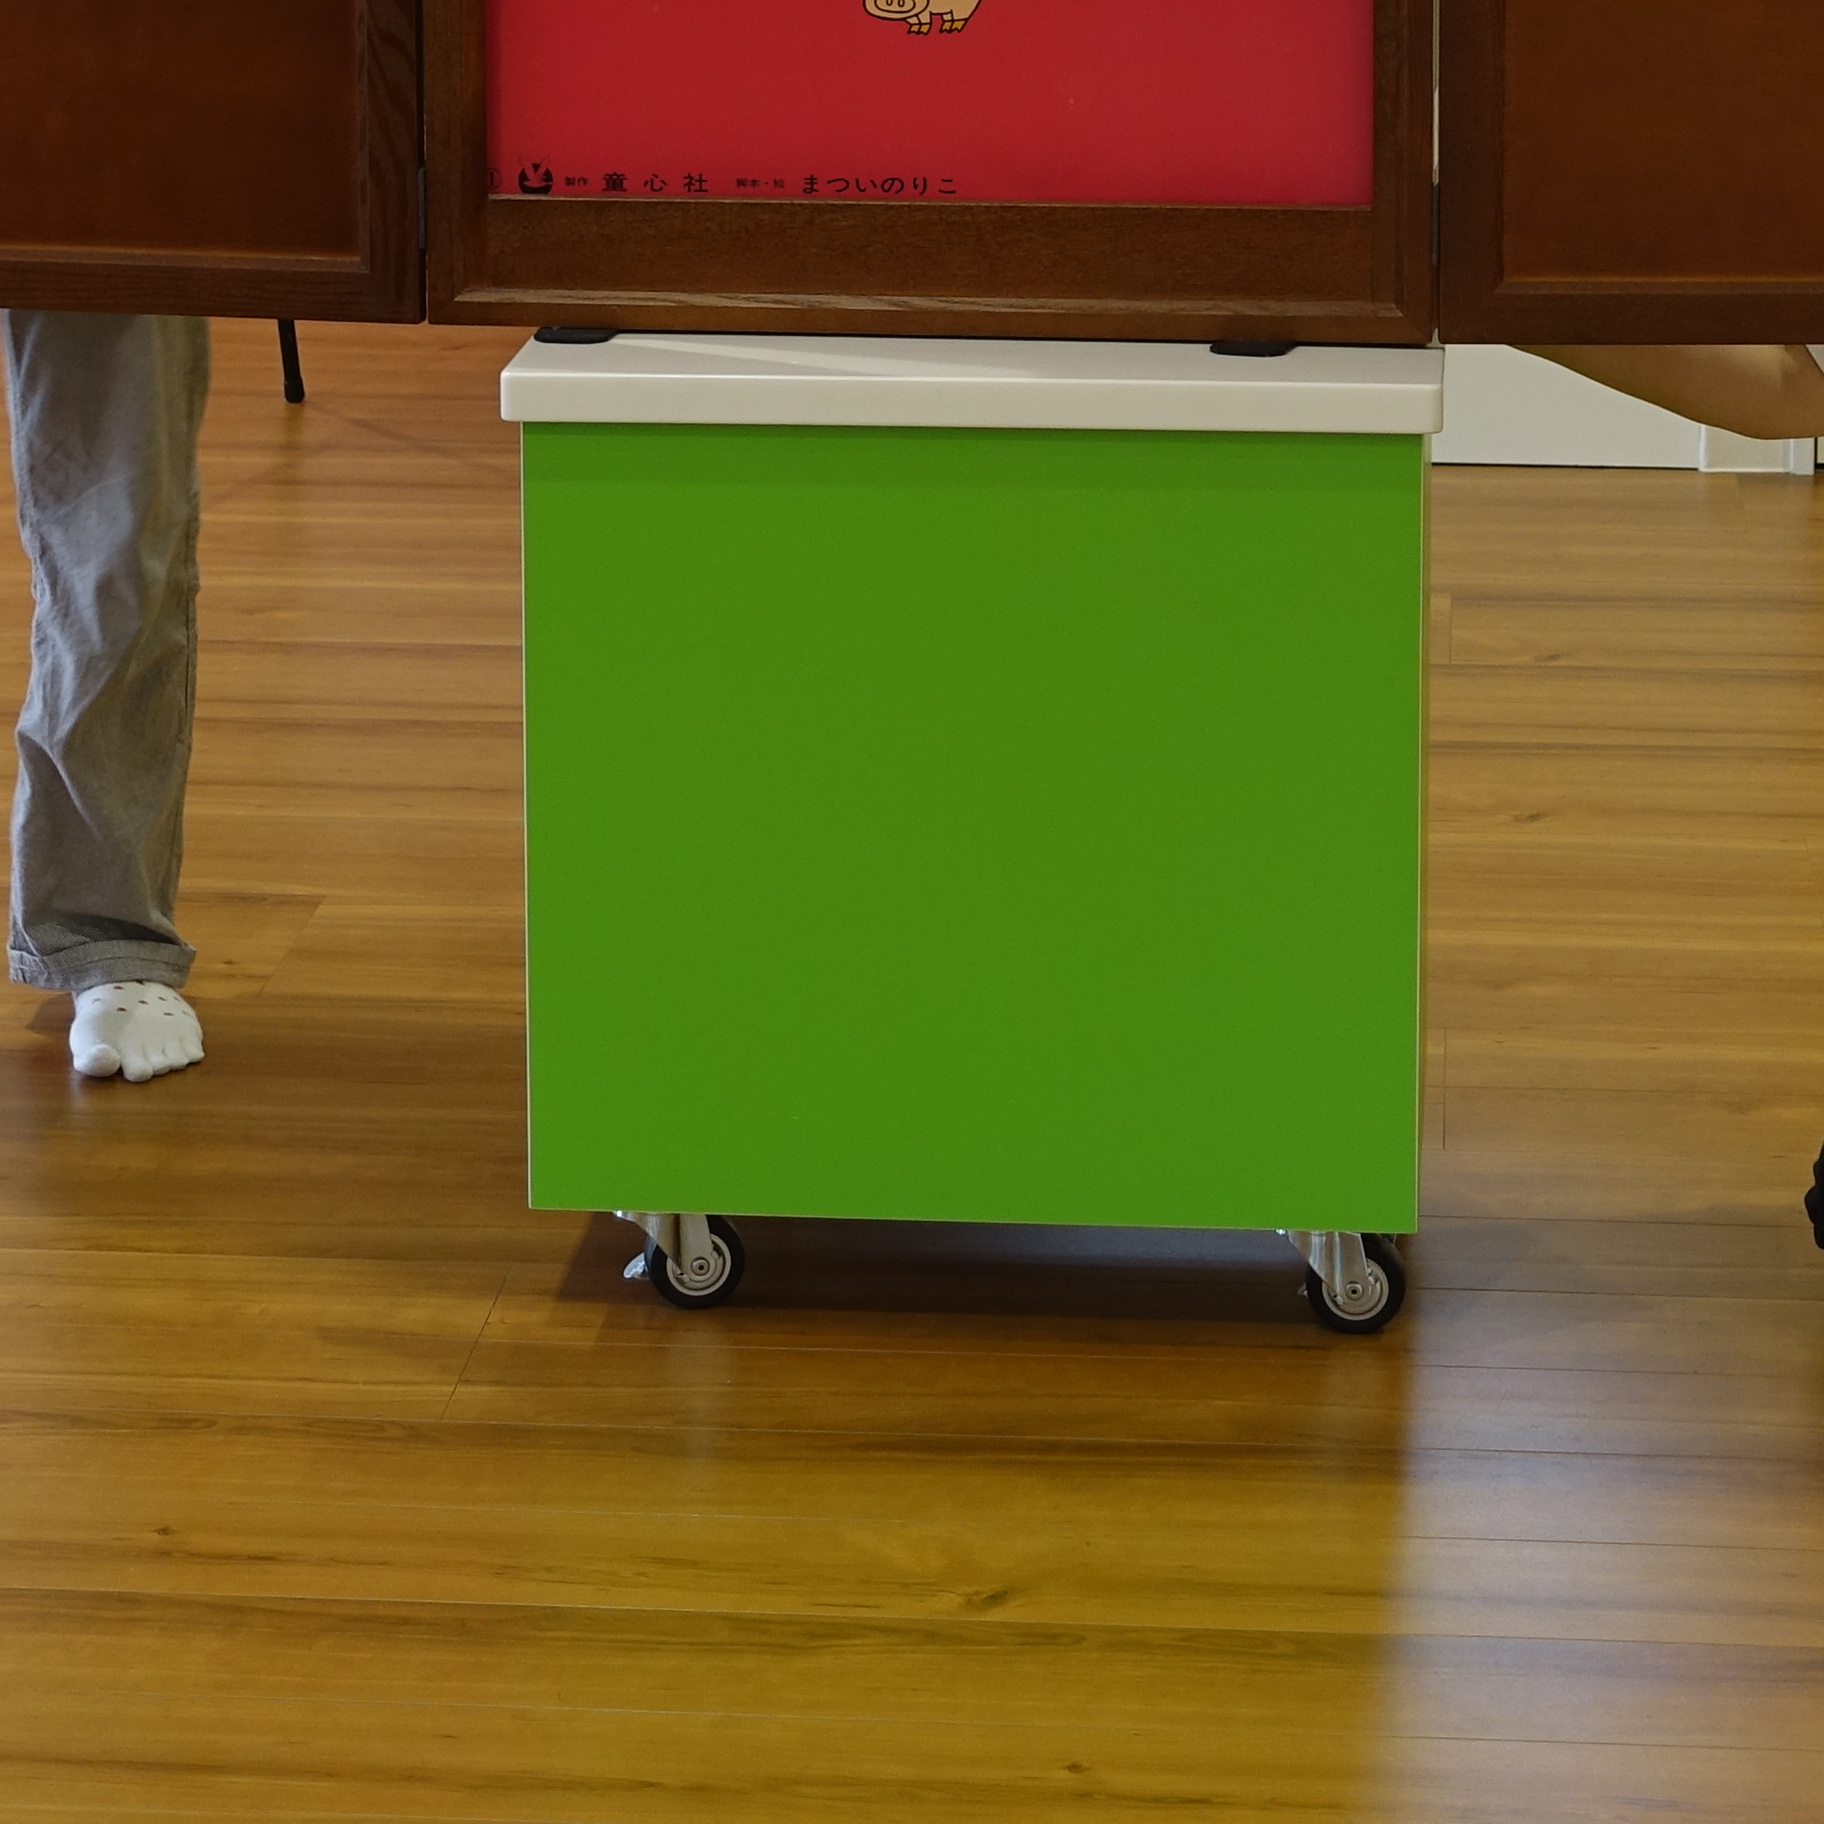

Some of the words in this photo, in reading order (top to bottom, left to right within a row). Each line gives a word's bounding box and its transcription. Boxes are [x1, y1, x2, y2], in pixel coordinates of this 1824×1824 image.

[602, 172, 709, 193] 童心社
[802, 175, 957, 195] まついのりこ
